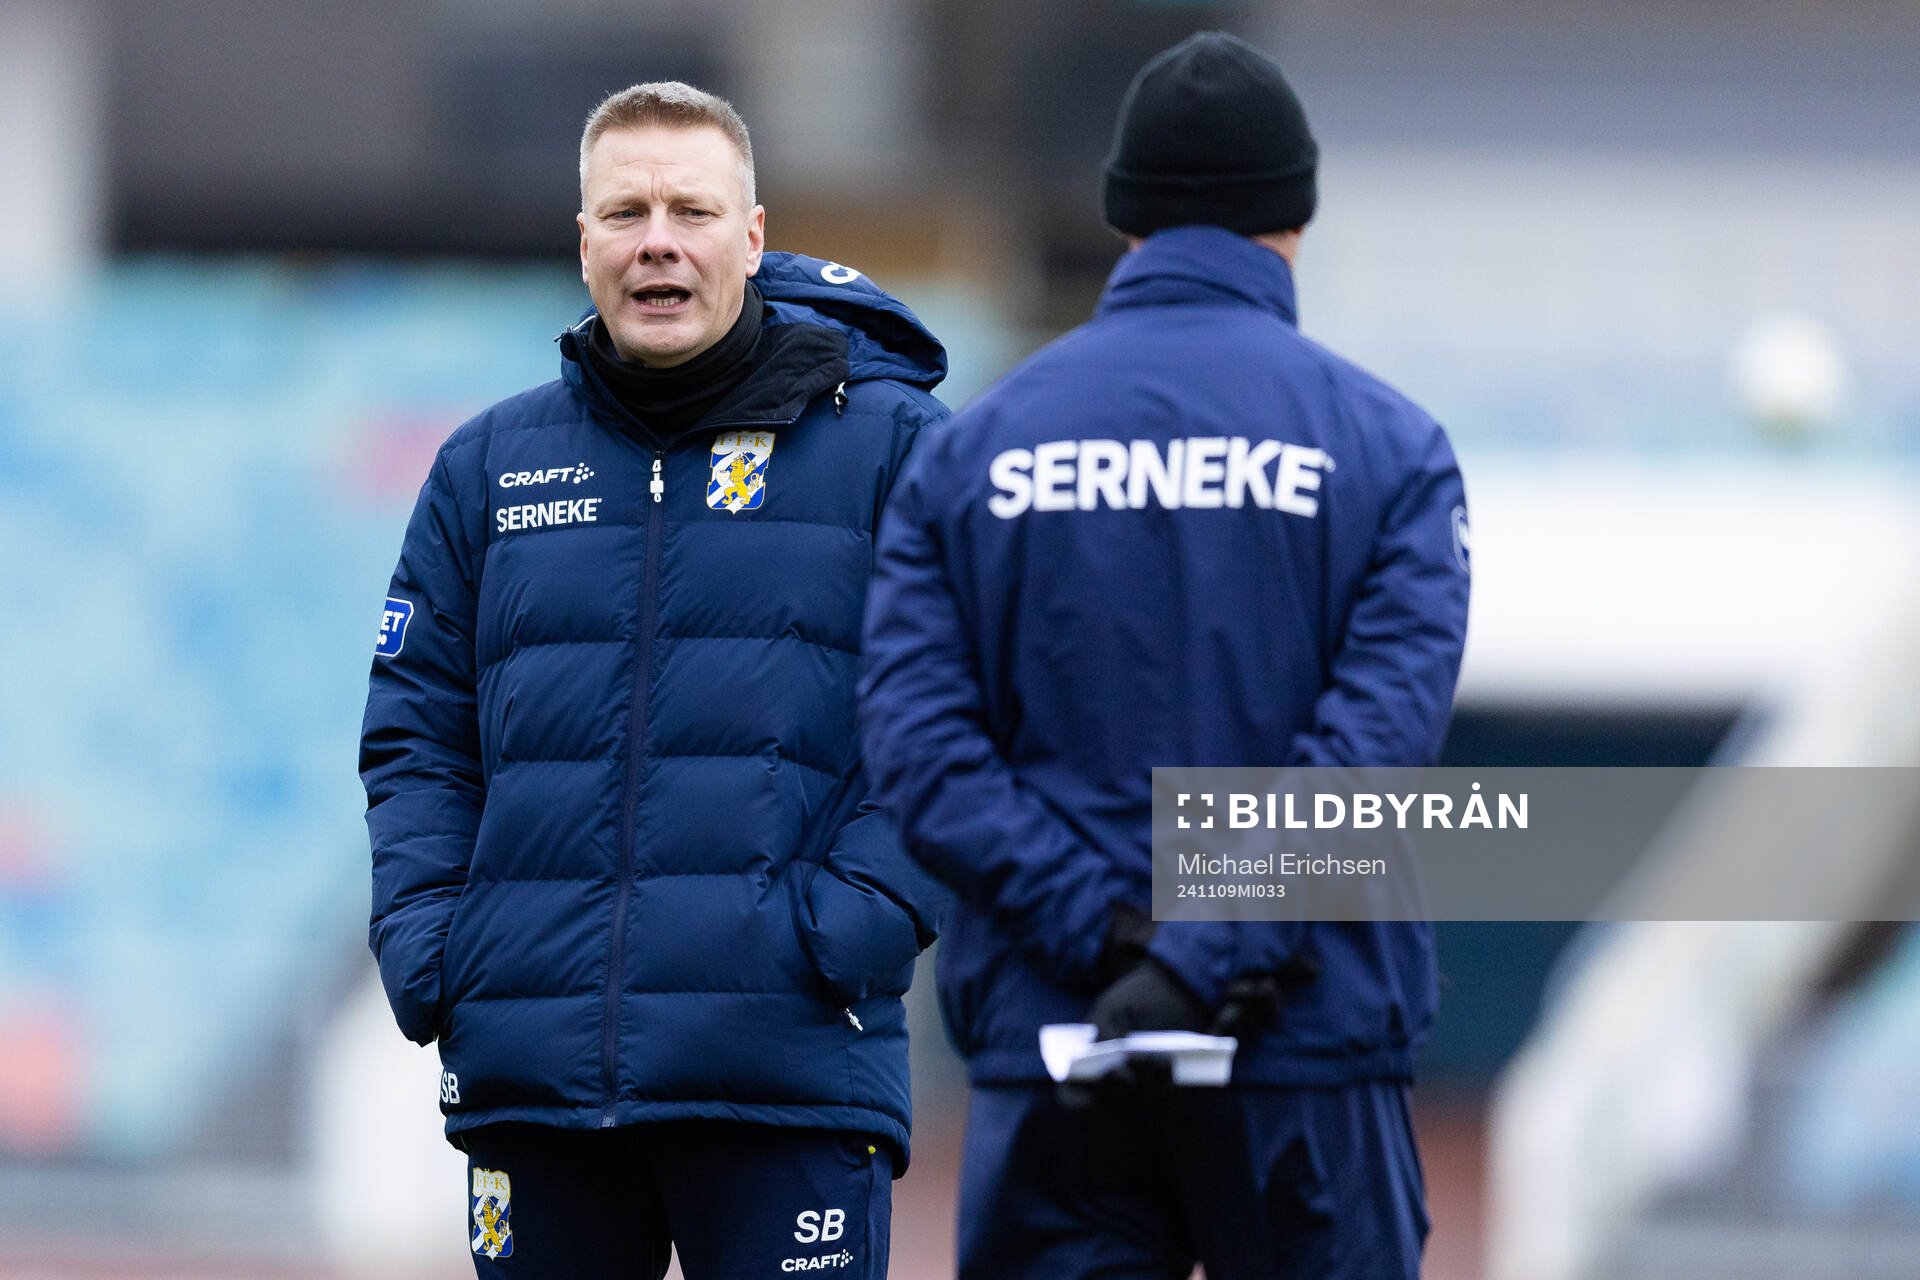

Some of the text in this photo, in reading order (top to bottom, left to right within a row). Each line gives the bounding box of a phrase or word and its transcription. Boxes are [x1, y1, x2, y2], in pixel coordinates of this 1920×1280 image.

[498, 467, 575, 488] CRAFT
[987, 437, 1320, 519] SERNEKE
[496, 498, 598, 533] SERNEKE
[440, 1070, 461, 1104] SB
[793, 1208, 846, 1244] SB
[781, 1253, 841, 1272] CRAFT
